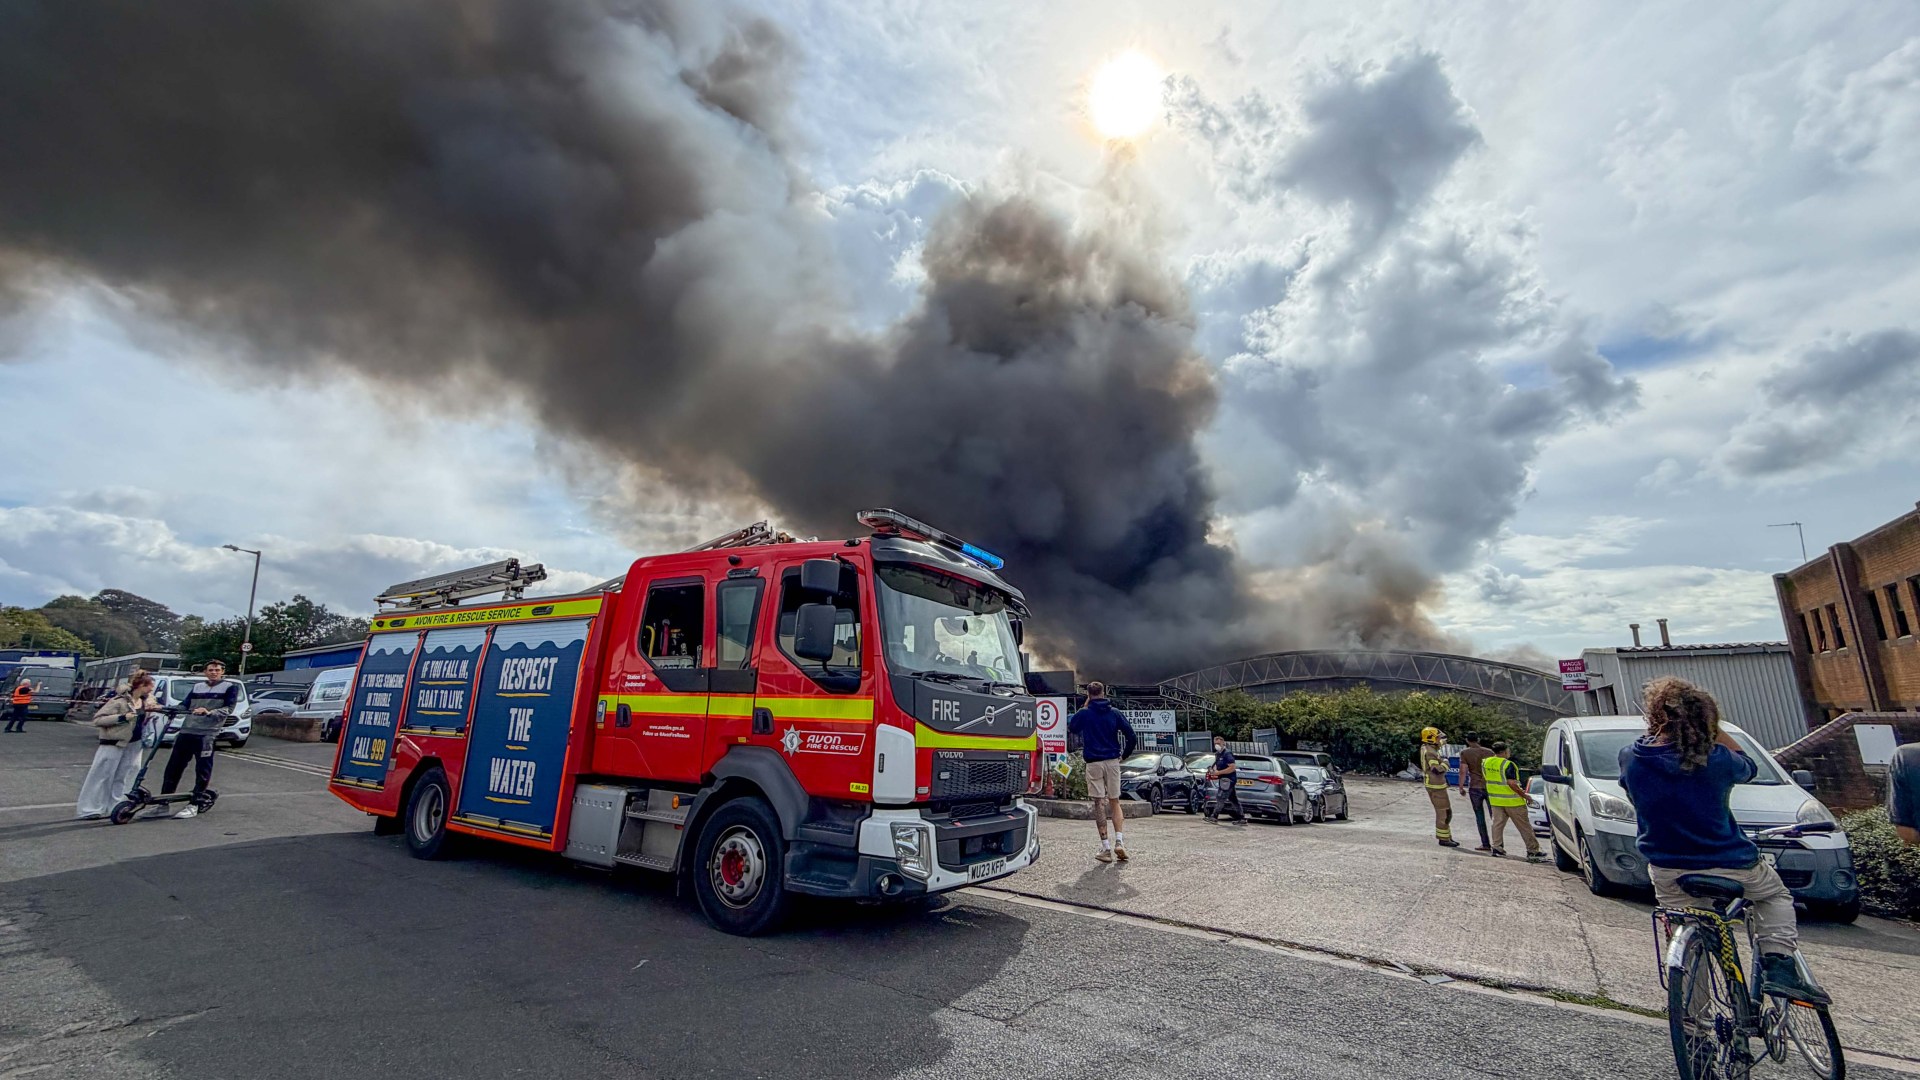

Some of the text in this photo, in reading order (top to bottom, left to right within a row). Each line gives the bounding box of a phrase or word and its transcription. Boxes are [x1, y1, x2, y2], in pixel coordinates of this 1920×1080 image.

[414, 608, 522, 626] AVON FIRE & RESCUE SERVICE
[420, 660, 431, 679] IF
[429, 660, 444, 679] YOU
[441, 660, 458, 679] FALL
[498, 657, 558, 691] RESPECT
[360, 674, 405, 689] IF YOU SEE SOMEONE
[365, 692, 392, 707] IN TROUBLE
[417, 690, 464, 709] FLOAT TO LIVE
[358, 711, 366, 725] IN
[364, 711, 374, 726] THE
[932, 699, 960, 722] FIRE
[1040, 705, 1051, 721] 5
[507, 708, 534, 742] THE
[806, 734, 842, 744] AVON
[830, 744, 860, 752] RESCUE
[352, 736, 387, 761] CALL 999
[938, 751, 964, 759] VOLVO
[489, 757, 536, 797] WATER
[971, 859, 1005, 880] WU23 KFP
